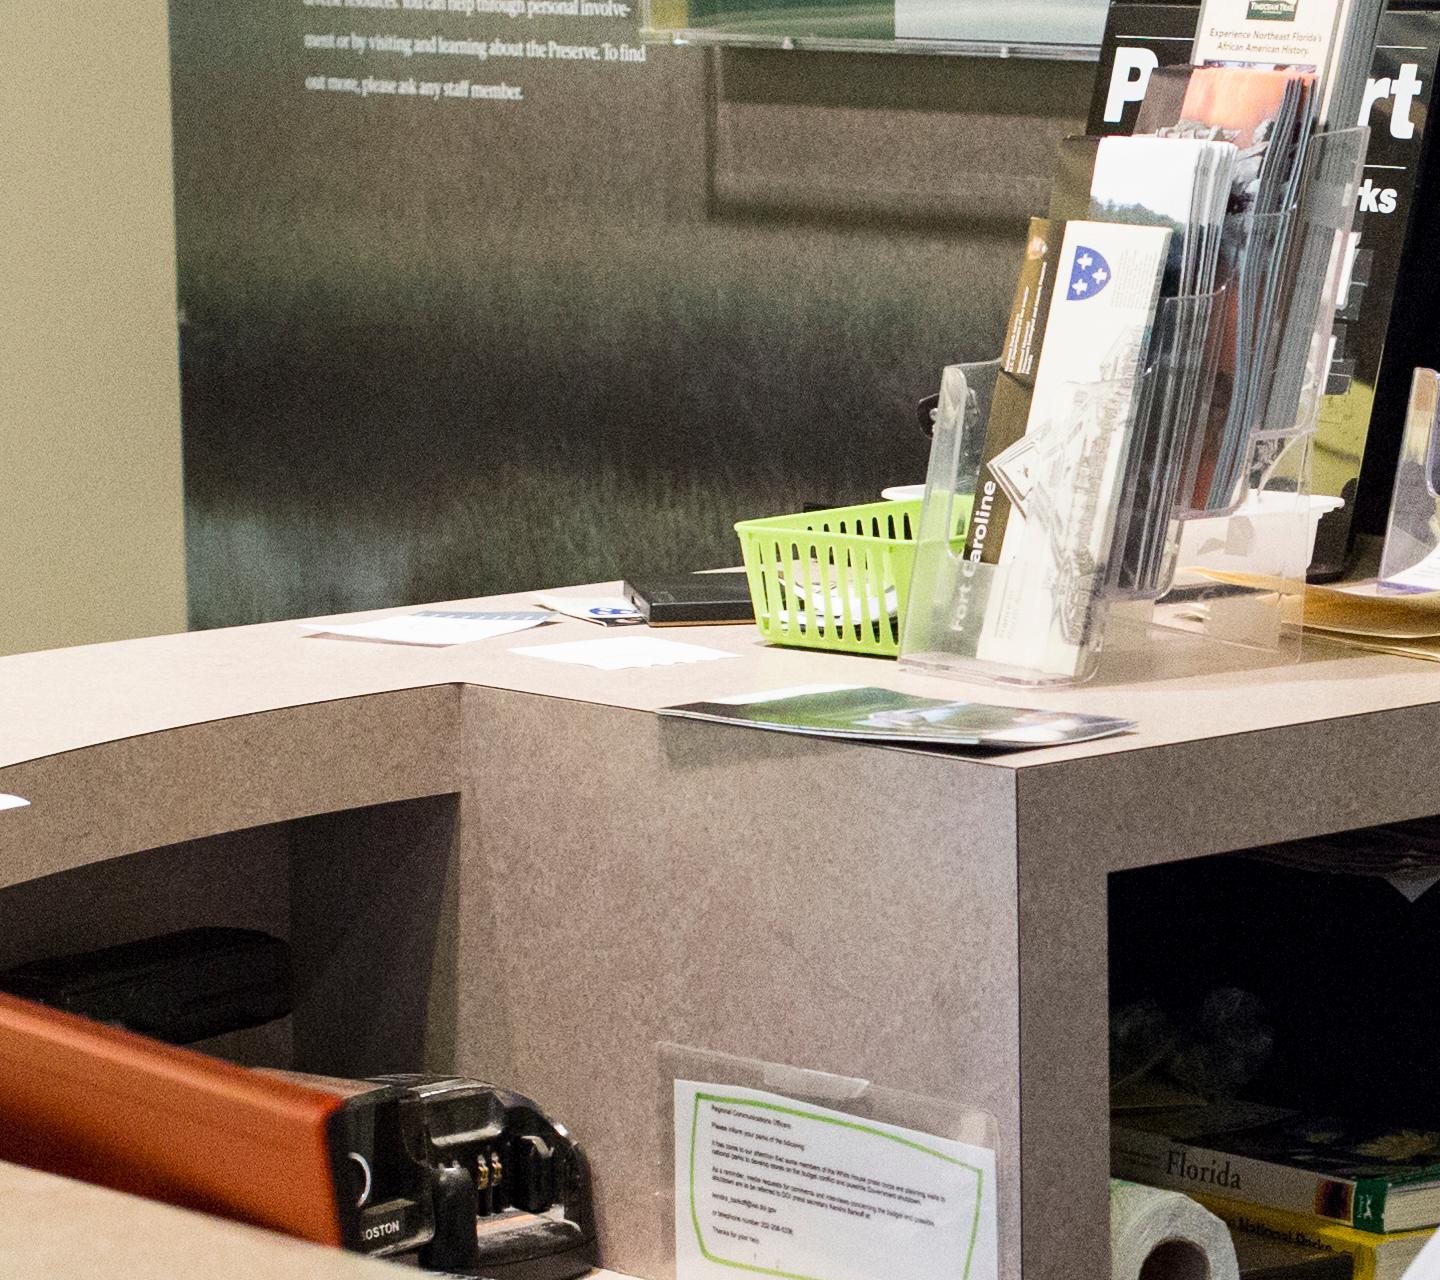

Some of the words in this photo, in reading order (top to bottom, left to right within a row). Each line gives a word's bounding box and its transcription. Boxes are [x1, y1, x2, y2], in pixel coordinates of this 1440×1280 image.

[1209, 27, 1252, 41] Experience
[1252, 30, 1291, 42] Northeast
[1292, 31, 1323, 44] Florida's
[1216, 41, 1245, 53] African
[1245, 43, 1280, 55] American
[1281, 43, 1309, 58] History.
[967, 479, 998, 578] Caroline
[1164, 1149, 1242, 1190] Florida
